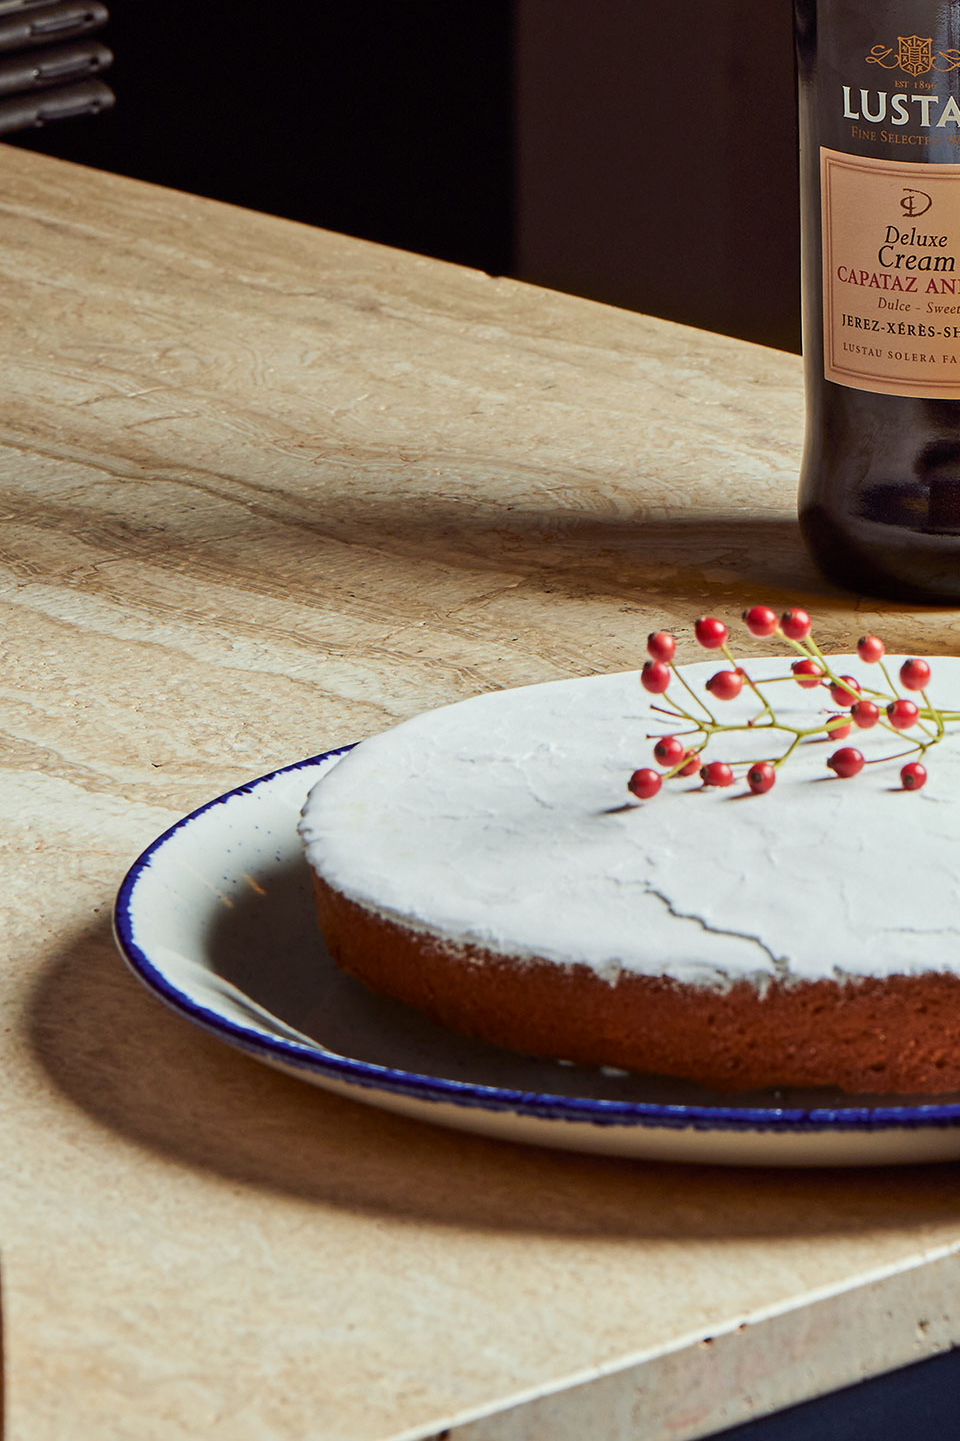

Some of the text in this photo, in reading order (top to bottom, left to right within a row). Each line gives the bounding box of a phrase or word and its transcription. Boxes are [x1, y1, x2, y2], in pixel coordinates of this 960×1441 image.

[895, 80, 909, 88] EST
[851, 126, 877, 141] FINE
[884, 225, 948, 248] Deluxe
[878, 245, 955, 272] Cream
[837, 265, 918, 293] CAPATAZ
[878, 297, 911, 312] Dulce
[926, 301, 960, 314] Sweet
[843, 343, 882, 358] LUSTAU
[888, 350, 936, 363] SOLERA
